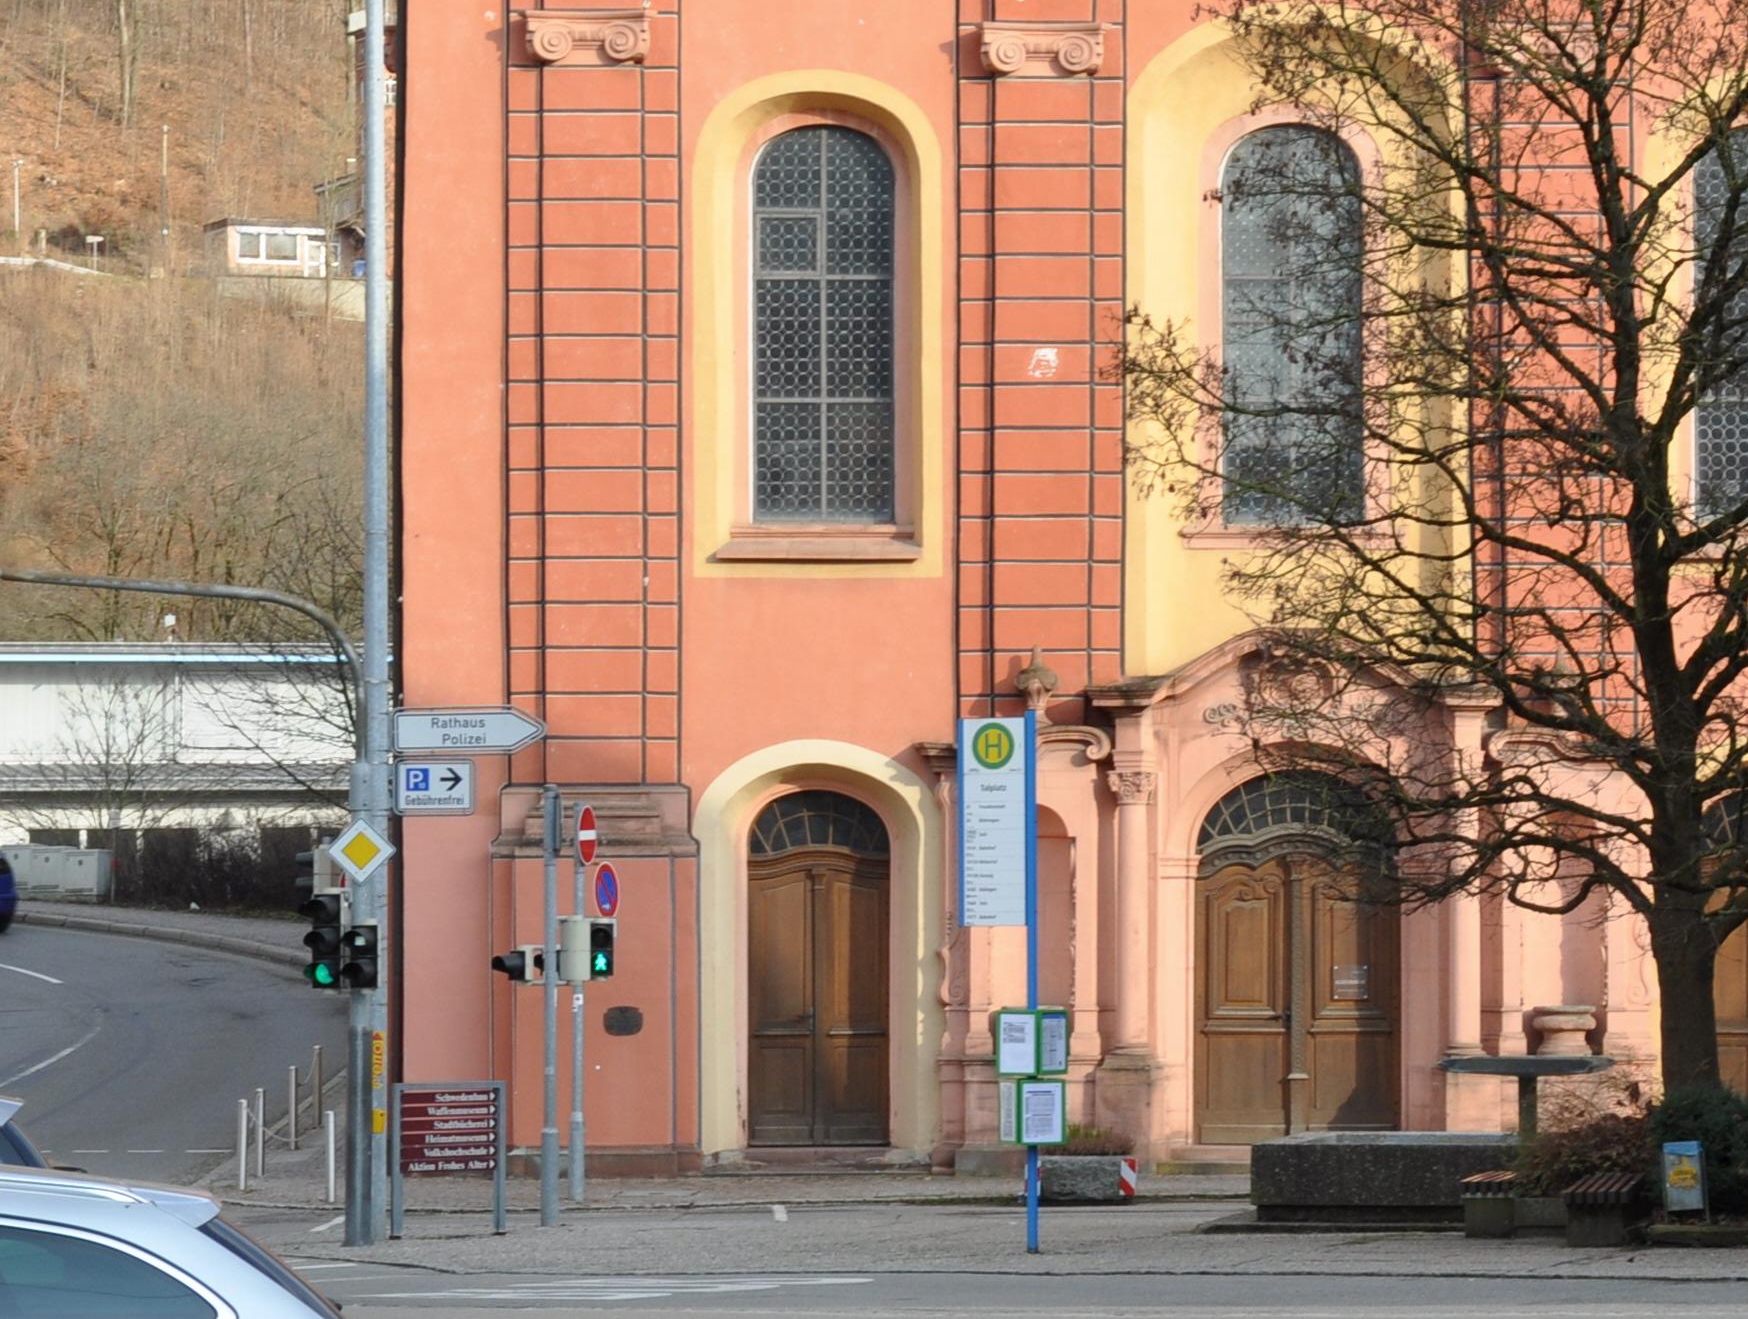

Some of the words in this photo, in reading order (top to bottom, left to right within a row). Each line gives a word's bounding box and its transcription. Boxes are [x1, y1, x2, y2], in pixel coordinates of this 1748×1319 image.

[431, 717, 486, 729] Rathaus
[442, 732, 487, 745] Polizei
[984, 732, 1003, 760] H
[408, 770, 424, 790] P
[405, 794, 465, 806] Gebührenfrei
[425, 1133, 488, 1143] Heimatmuseum
[423, 1146, 488, 1157] Volkshochschule
[408, 1161, 436, 1172] Aktion
[467, 1159, 488, 1170] Alter
